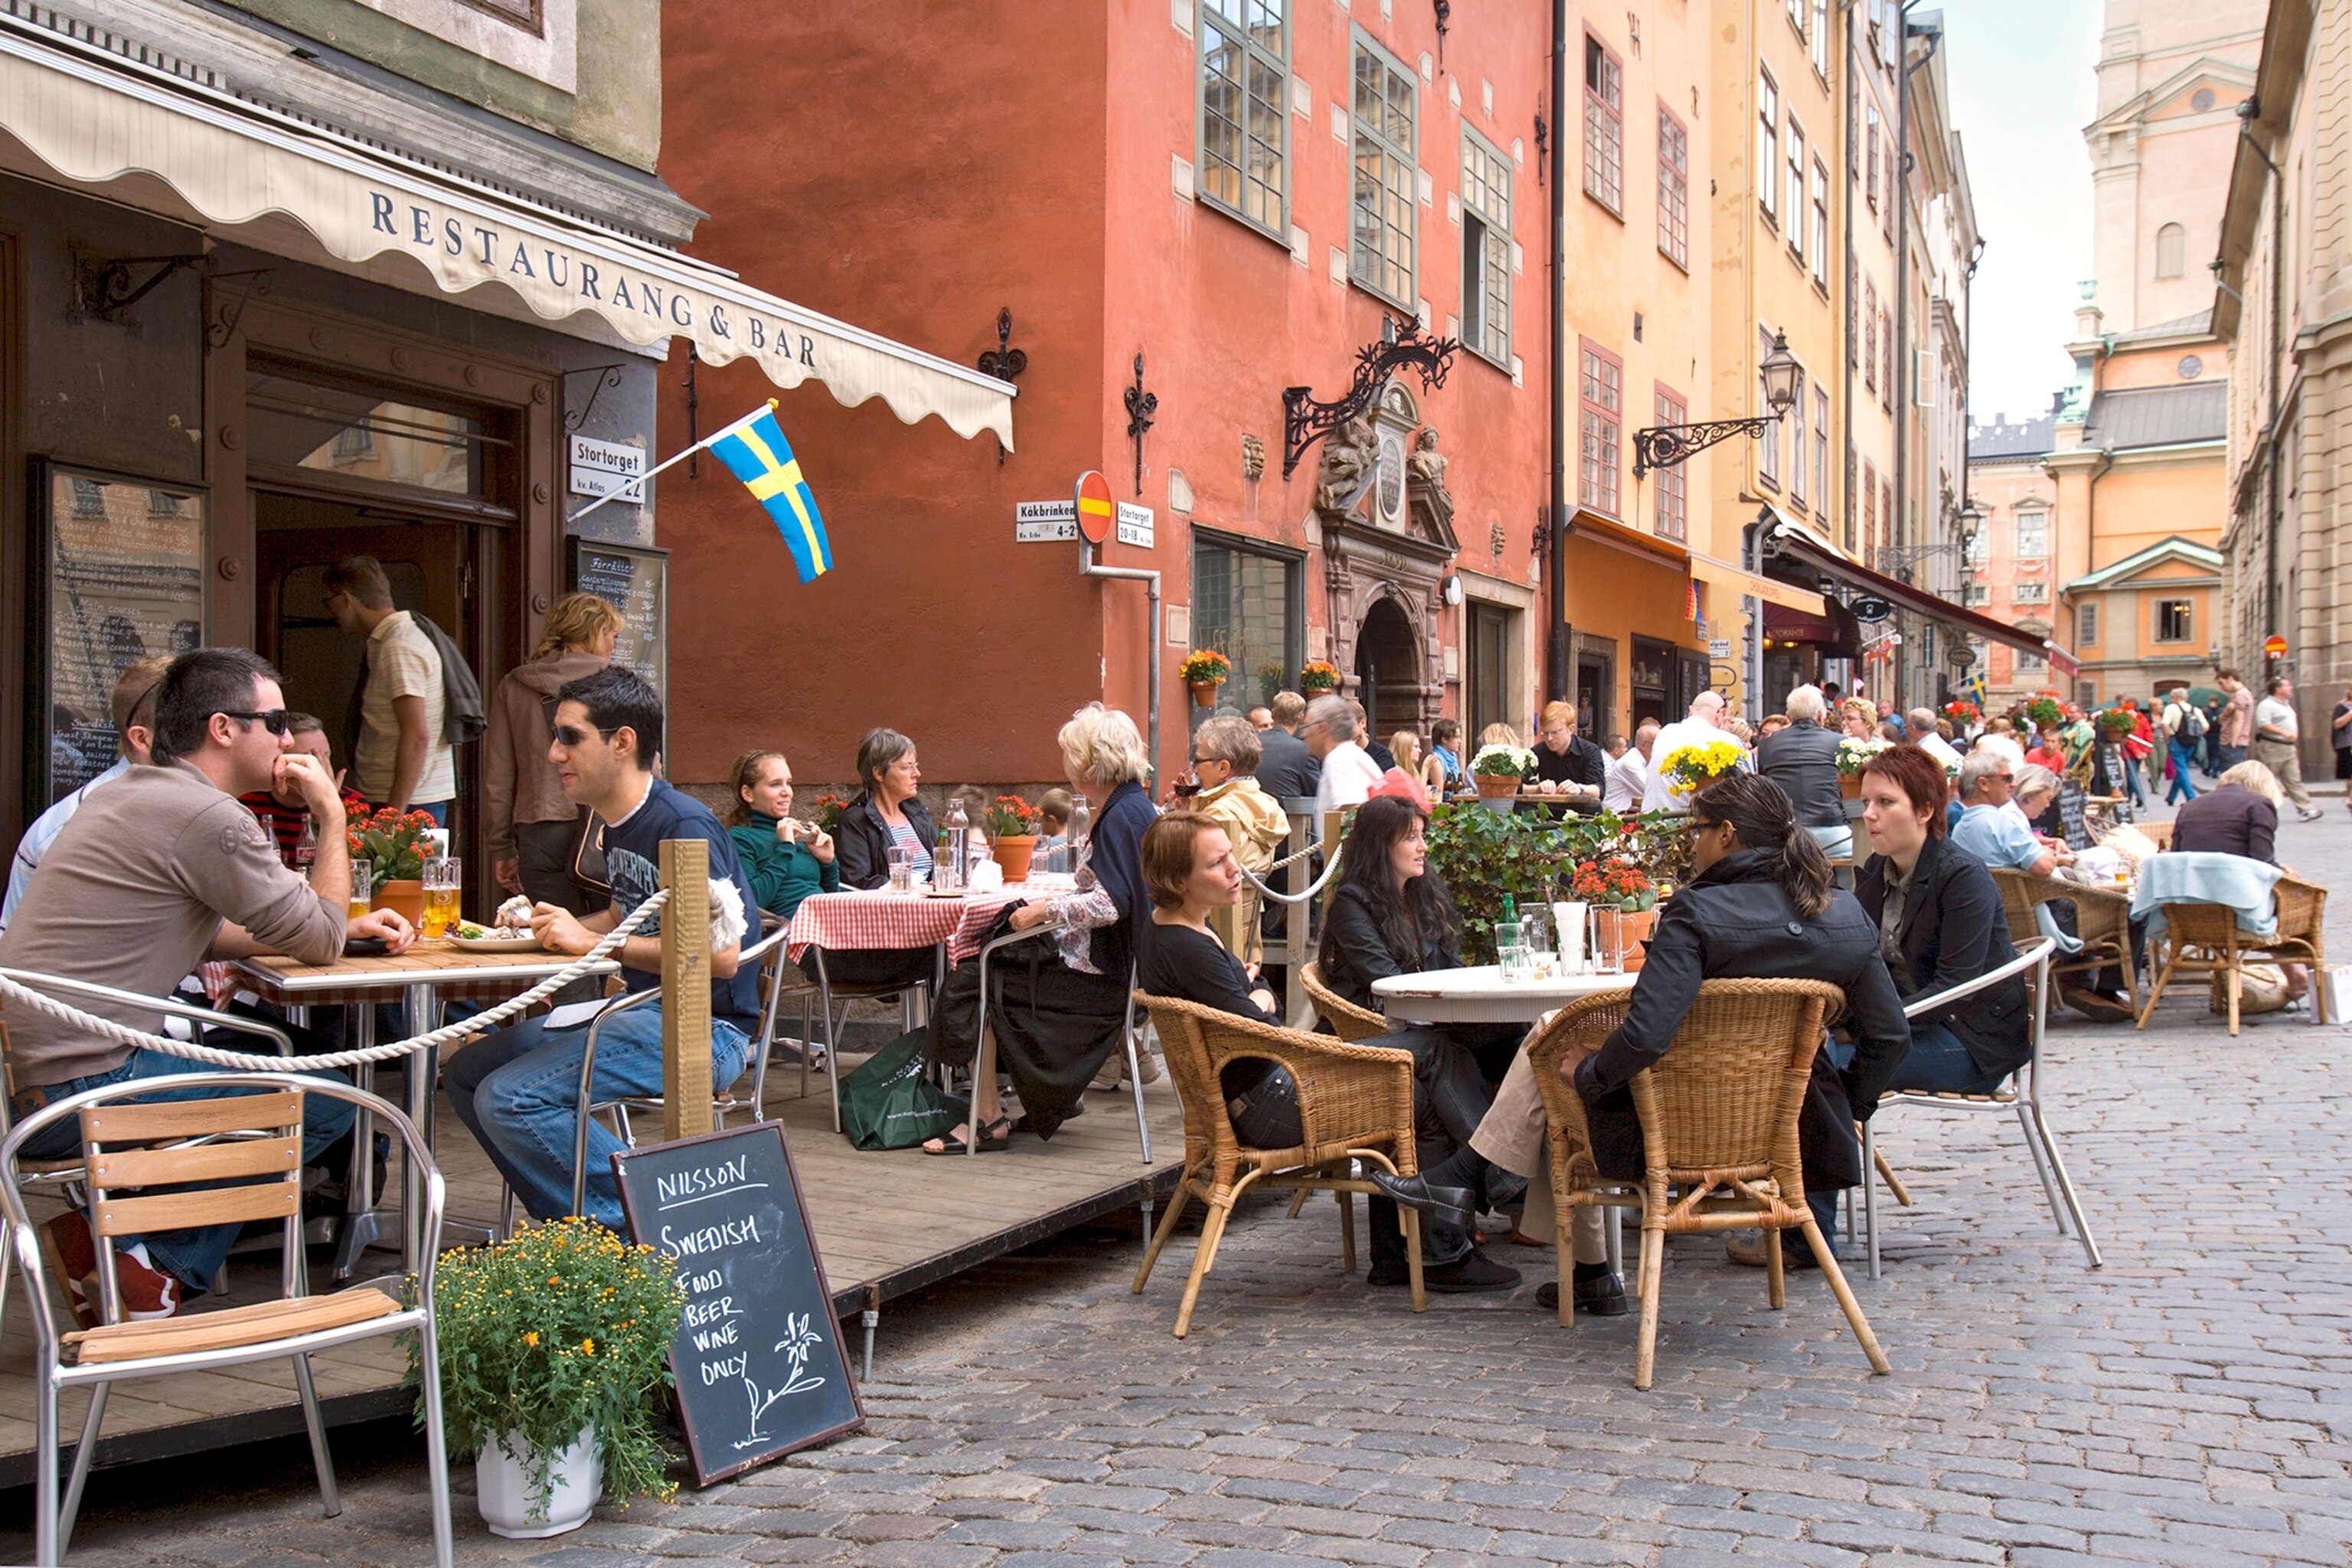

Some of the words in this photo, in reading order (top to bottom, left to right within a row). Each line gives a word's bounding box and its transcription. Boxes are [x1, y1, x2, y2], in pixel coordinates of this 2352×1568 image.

[371, 191, 692, 326] RESTAURANG
[710, 305, 731, 339] &
[749, 316, 815, 368] BAR
[577, 443, 639, 472] Stortorget
[1021, 504, 1075, 518] Kåkbrinken
[1120, 506, 1149, 524] Stortorget
[1120, 528, 1138, 541] 20-18
[80, 597, 105, 612] Main
[107, 606, 142, 618] courses
[657, 1155, 746, 1203] NILSSON
[661, 1214, 760, 1259] SWEDISH
[675, 1268, 724, 1294] FOOD
[685, 1295, 744, 1328] BEER
[692, 1320, 740, 1353] WINE
[700, 1350, 748, 1387] ONLY
